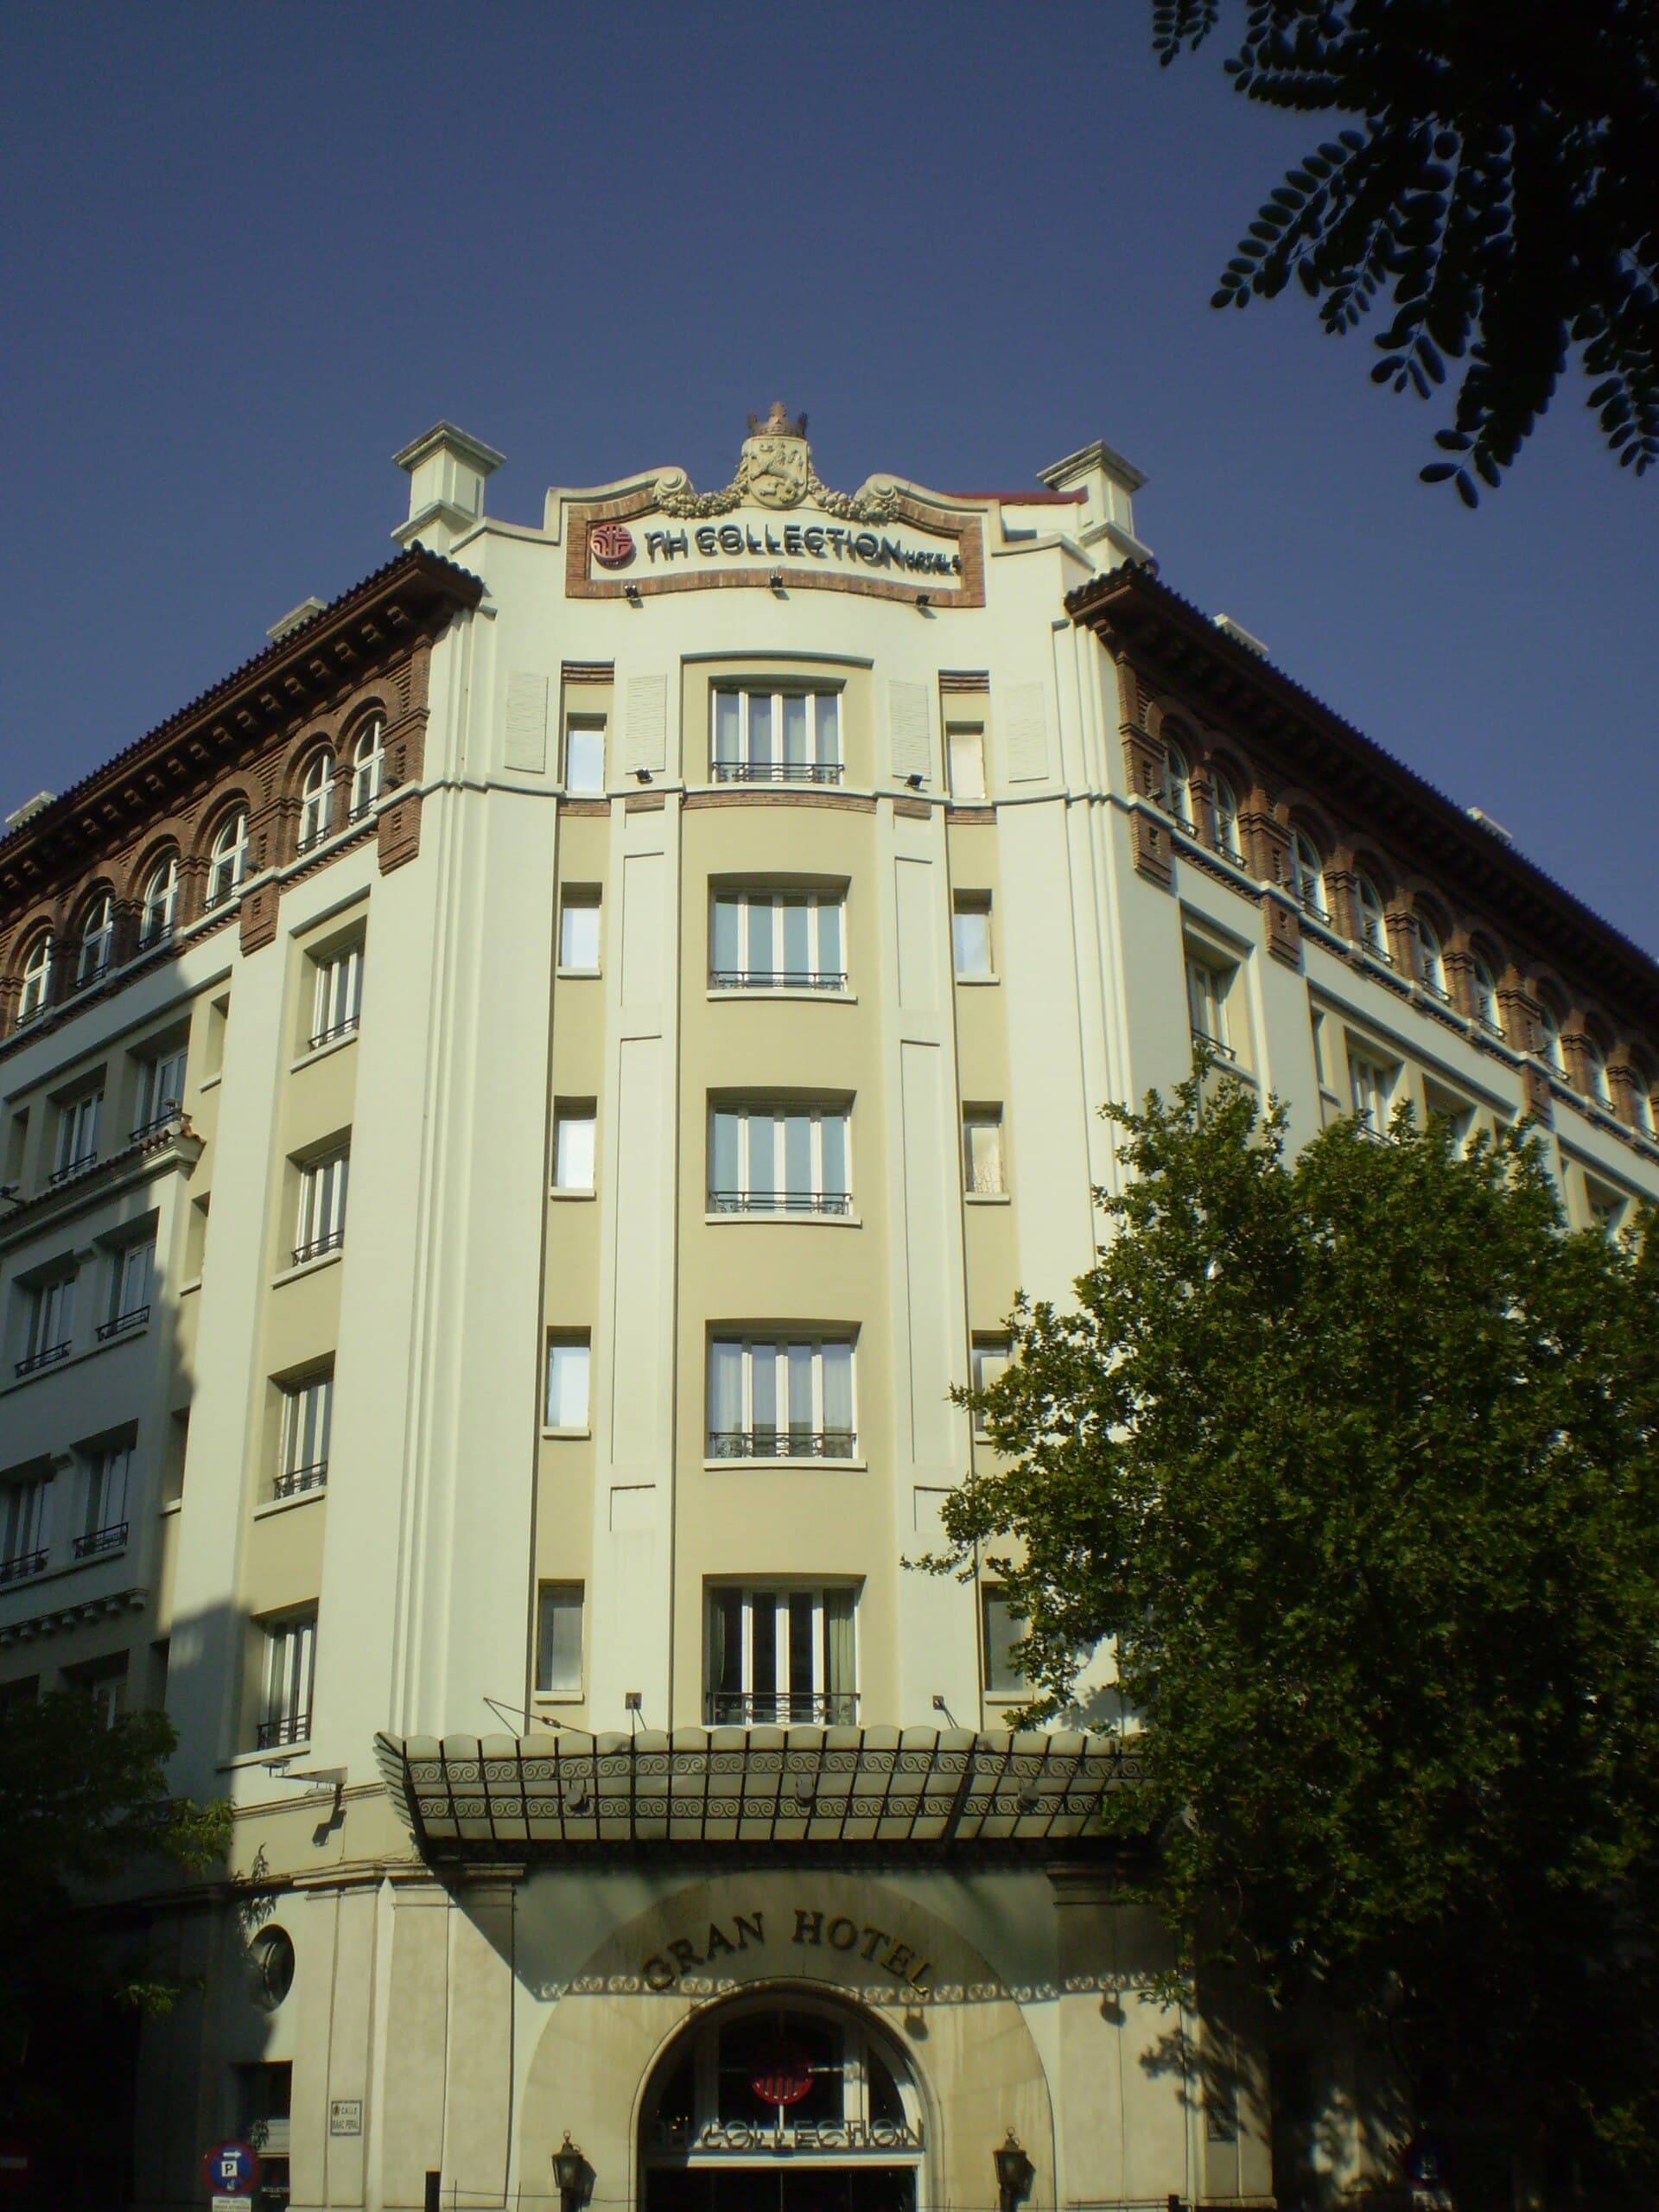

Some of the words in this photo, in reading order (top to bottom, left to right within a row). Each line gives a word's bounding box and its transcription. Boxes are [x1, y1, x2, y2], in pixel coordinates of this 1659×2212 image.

[695, 524, 904, 569] COLLECTION
[642, 1911, 766, 1991] GRAN
[792, 1910, 931, 1995] HOTEL
[699, 2120, 925, 2150] COLLECTION
[225, 2163, 234, 2175] P
